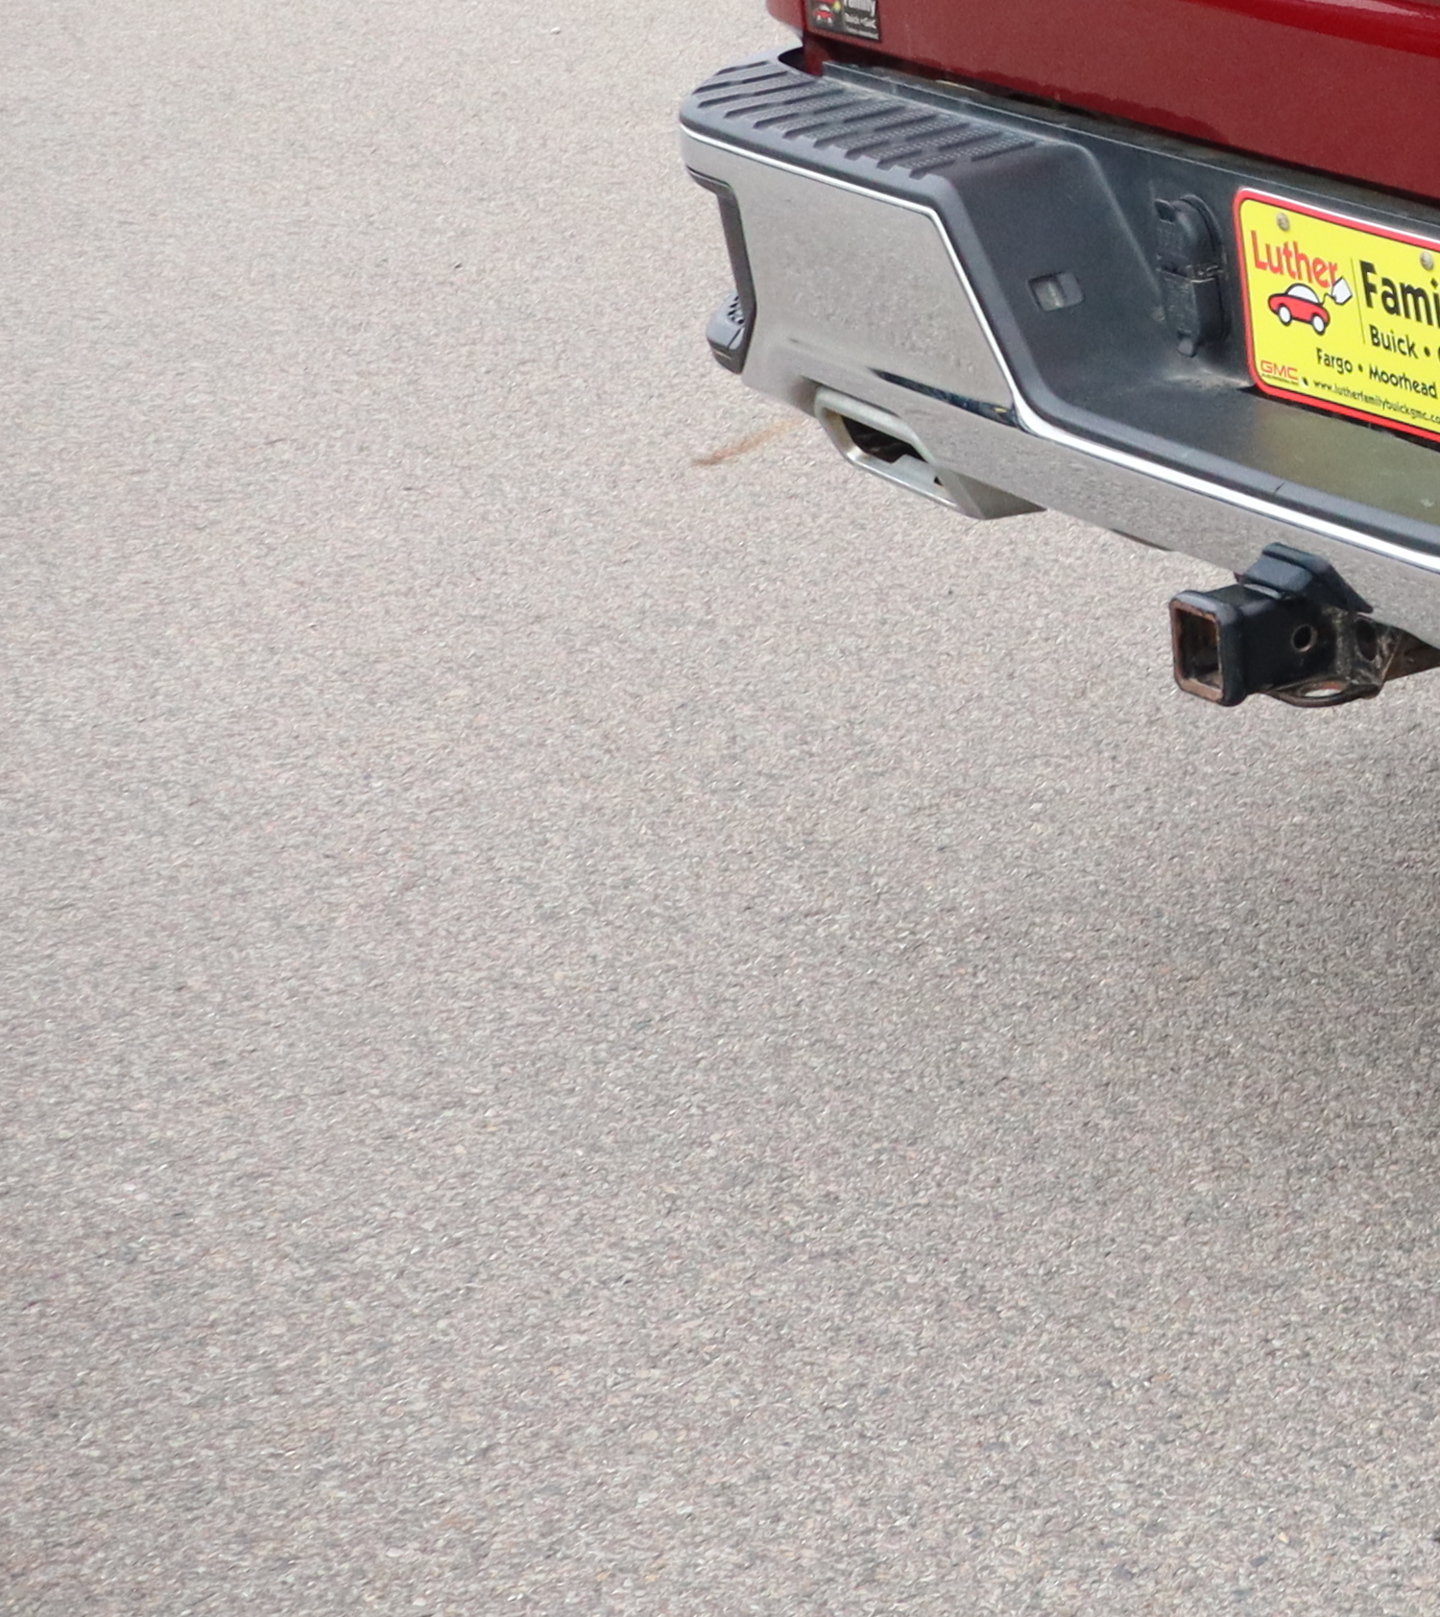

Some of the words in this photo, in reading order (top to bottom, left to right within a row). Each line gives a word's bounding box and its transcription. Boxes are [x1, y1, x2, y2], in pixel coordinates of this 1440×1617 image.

[1250, 230, 1339, 289] Luther
[1369, 324, 1418, 359] Buick
[1260, 360, 1299, 380] GMC
[1316, 348, 1353, 374] Fargo
[1369, 365, 1438, 399] Moorhead
